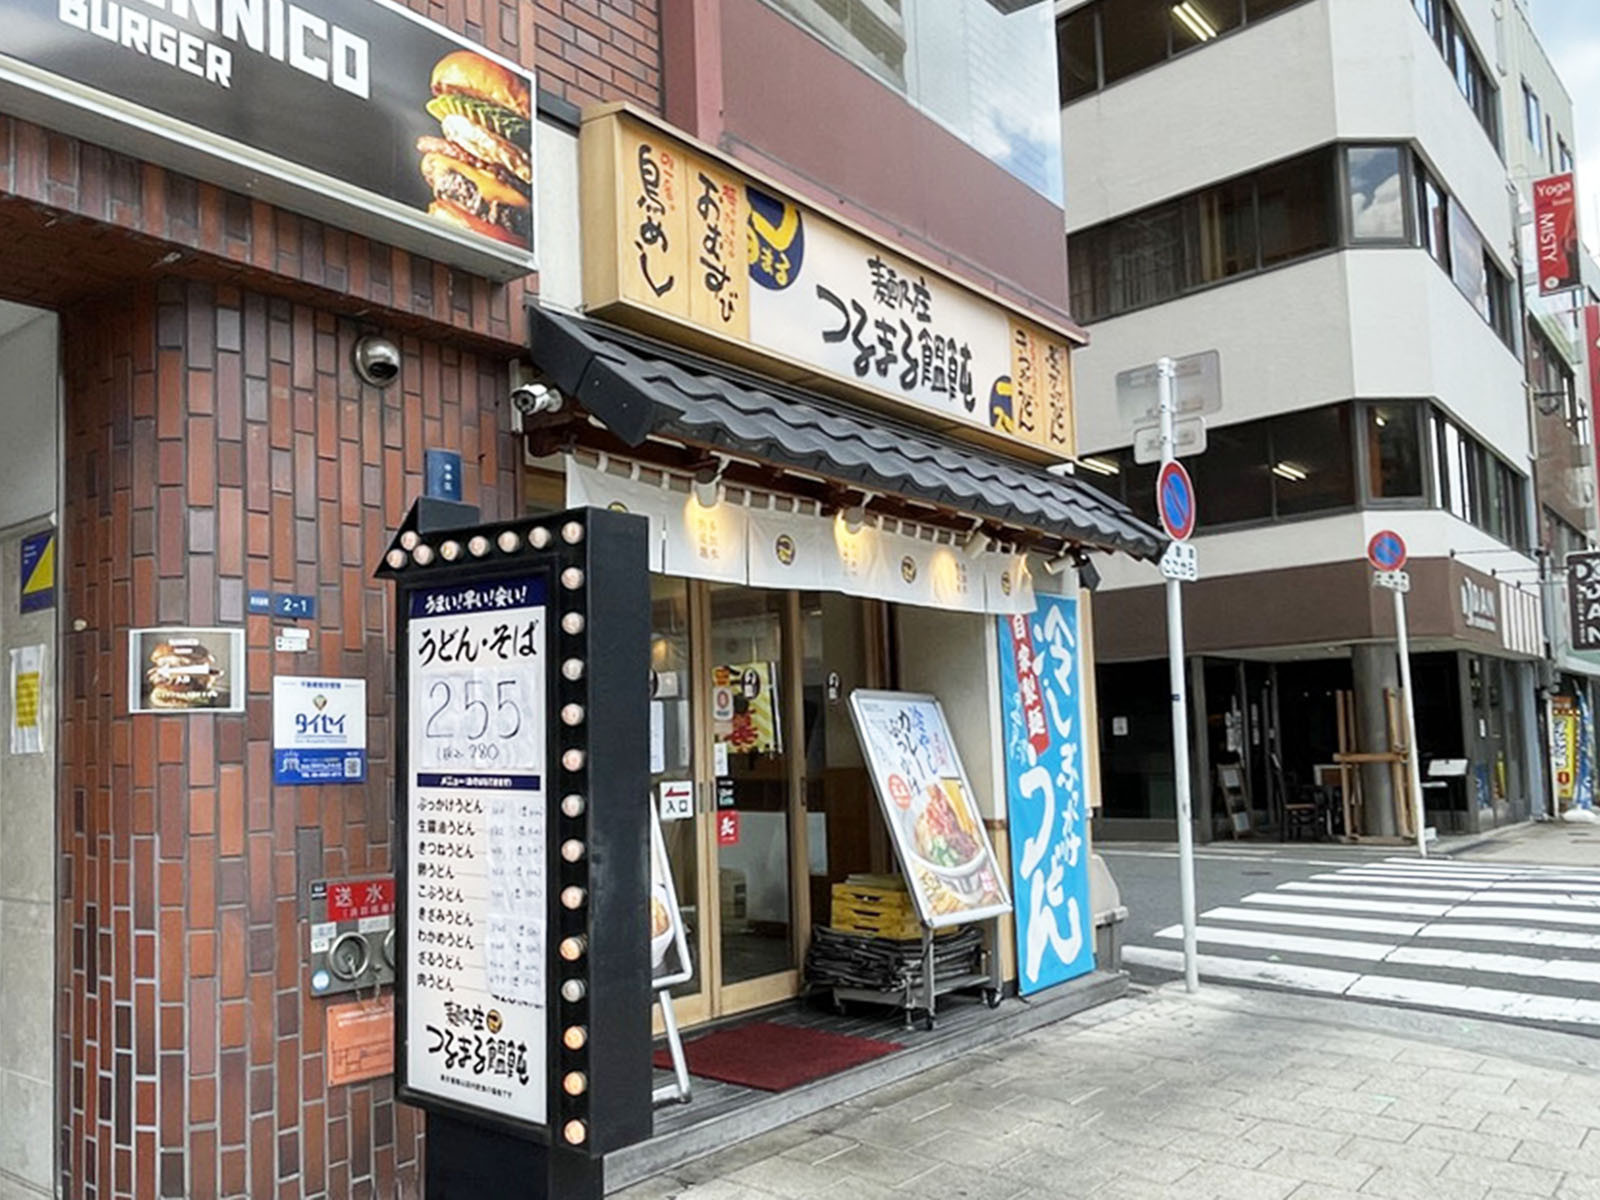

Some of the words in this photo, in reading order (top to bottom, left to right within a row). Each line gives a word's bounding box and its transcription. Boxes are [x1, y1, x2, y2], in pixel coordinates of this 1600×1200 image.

[57, 0, 232, 88] BURGER
[138, 0, 370, 100] NICO
[1536, 181, 1571, 197] Yoga
[697, 172, 739, 322] おむすび
[1539, 213, 1558, 262] MISTY
[816, 284, 976, 413] つるまる饂飩
[283, 598, 307, 612] 2-1
[425, 680, 521, 740] 255
[295, 713, 346, 734] タイセイ
[417, 797, 483, 814] ぶっかけうどん
[666, 799, 688, 814] 入口
[418, 841, 474, 859] きつねうどん
[418, 884, 464, 903] こぶうどん
[418, 906, 474, 926] きざみうどん
[418, 929, 474, 950] わかめうどん
[418, 951, 463, 971] ざるうどん
